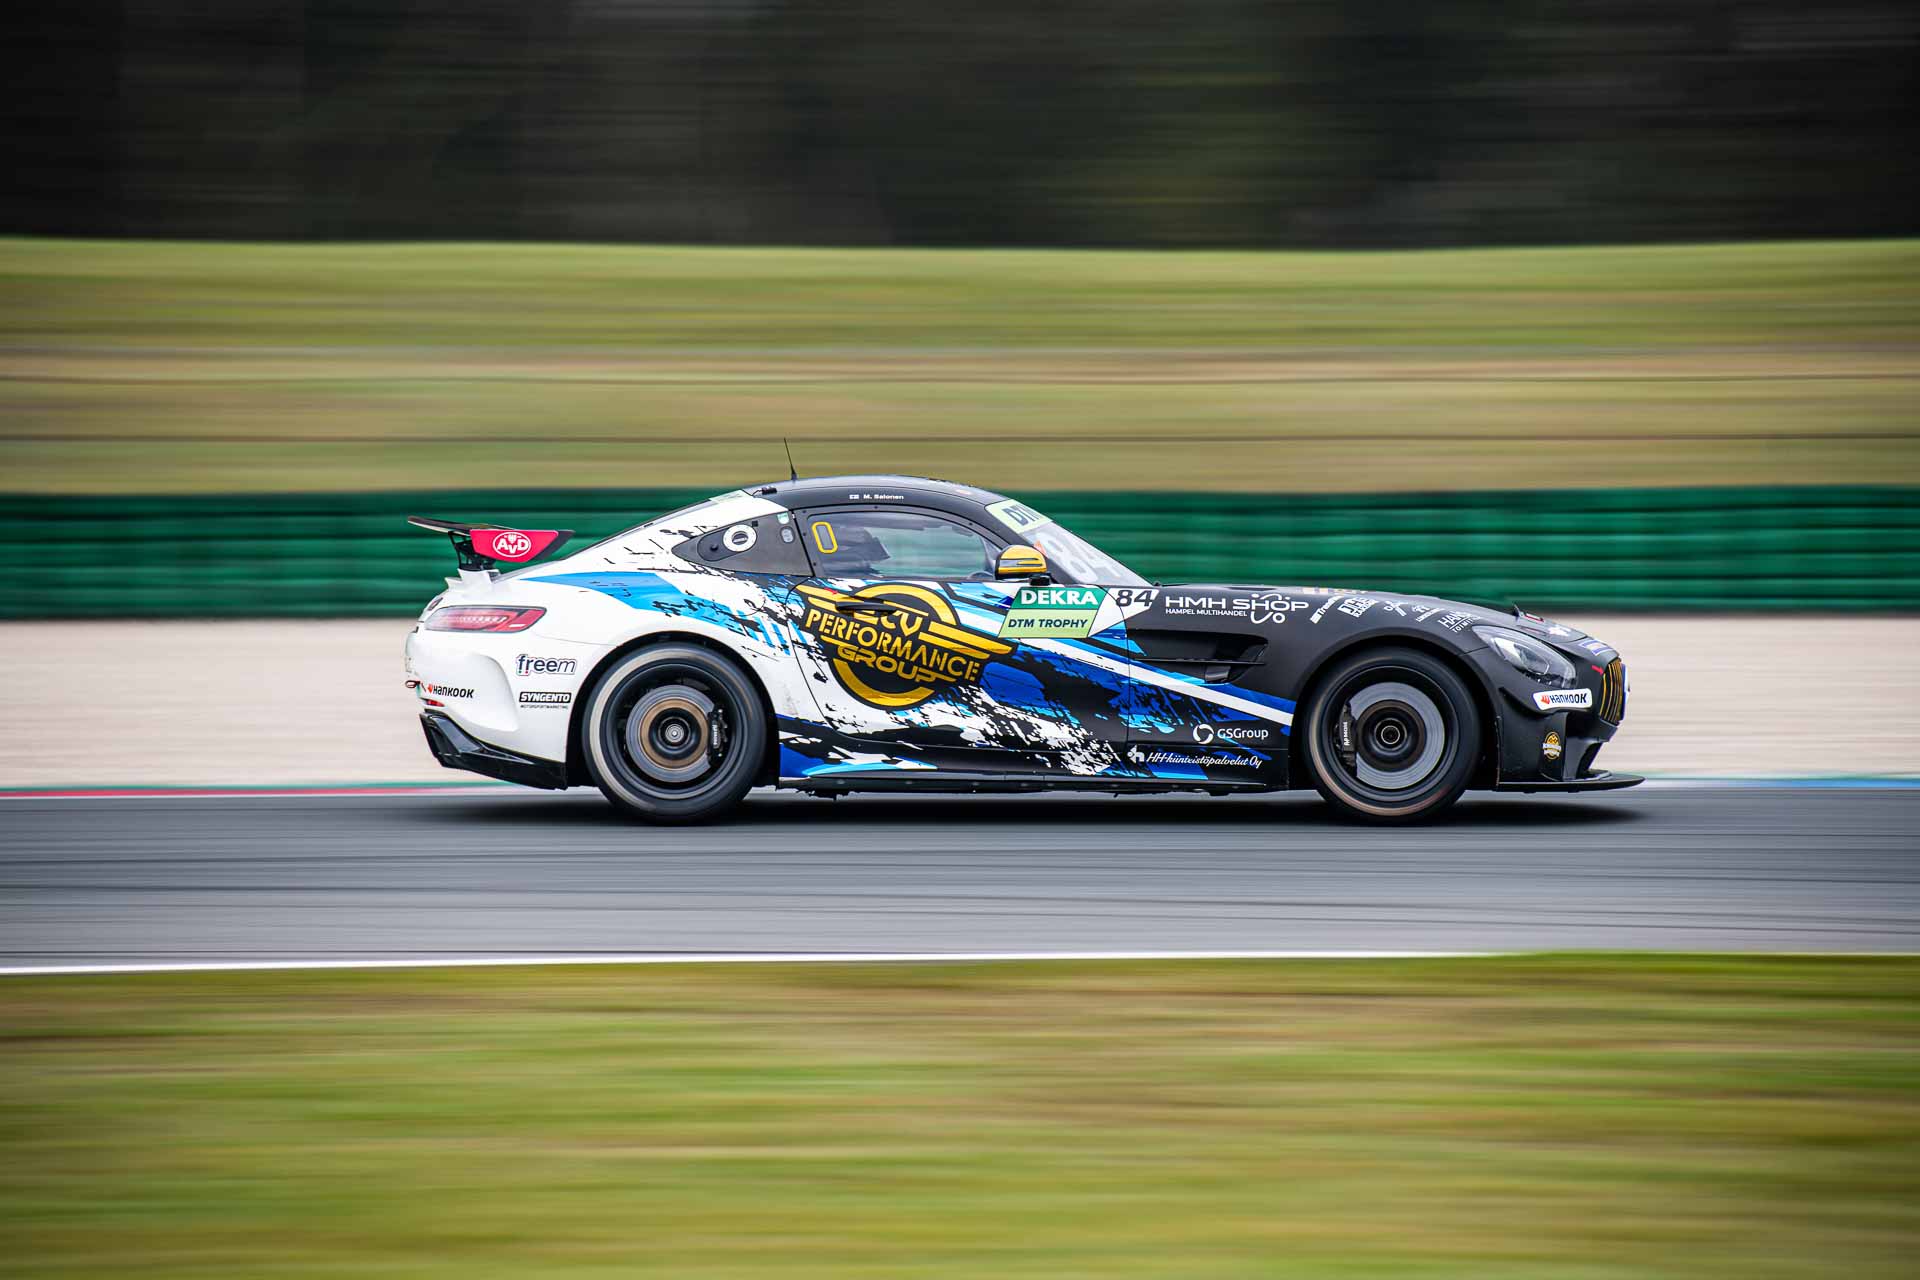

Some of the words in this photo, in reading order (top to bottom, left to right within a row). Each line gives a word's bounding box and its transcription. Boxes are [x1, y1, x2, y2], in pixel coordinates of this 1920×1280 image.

[1021, 589, 1099, 605] DEKRA
[1116, 589, 1153, 607] 84
[1165, 596, 1226, 609] HMH
[1233, 597, 1309, 612] SHOP
[1196, 609, 1248, 617] MULTIHANDEL
[1008, 618, 1035, 628] DTM
[1038, 618, 1088, 628] TROPHY
[805, 608, 982, 681] PERFORMANCE
[518, 653, 576, 675] freem
[838, 644, 942, 683] GROUP
[520, 692, 570, 702] SYNGENTO
[1217, 728, 1269, 741] GSGroup
[1249, 755, 1263, 769] Oy
